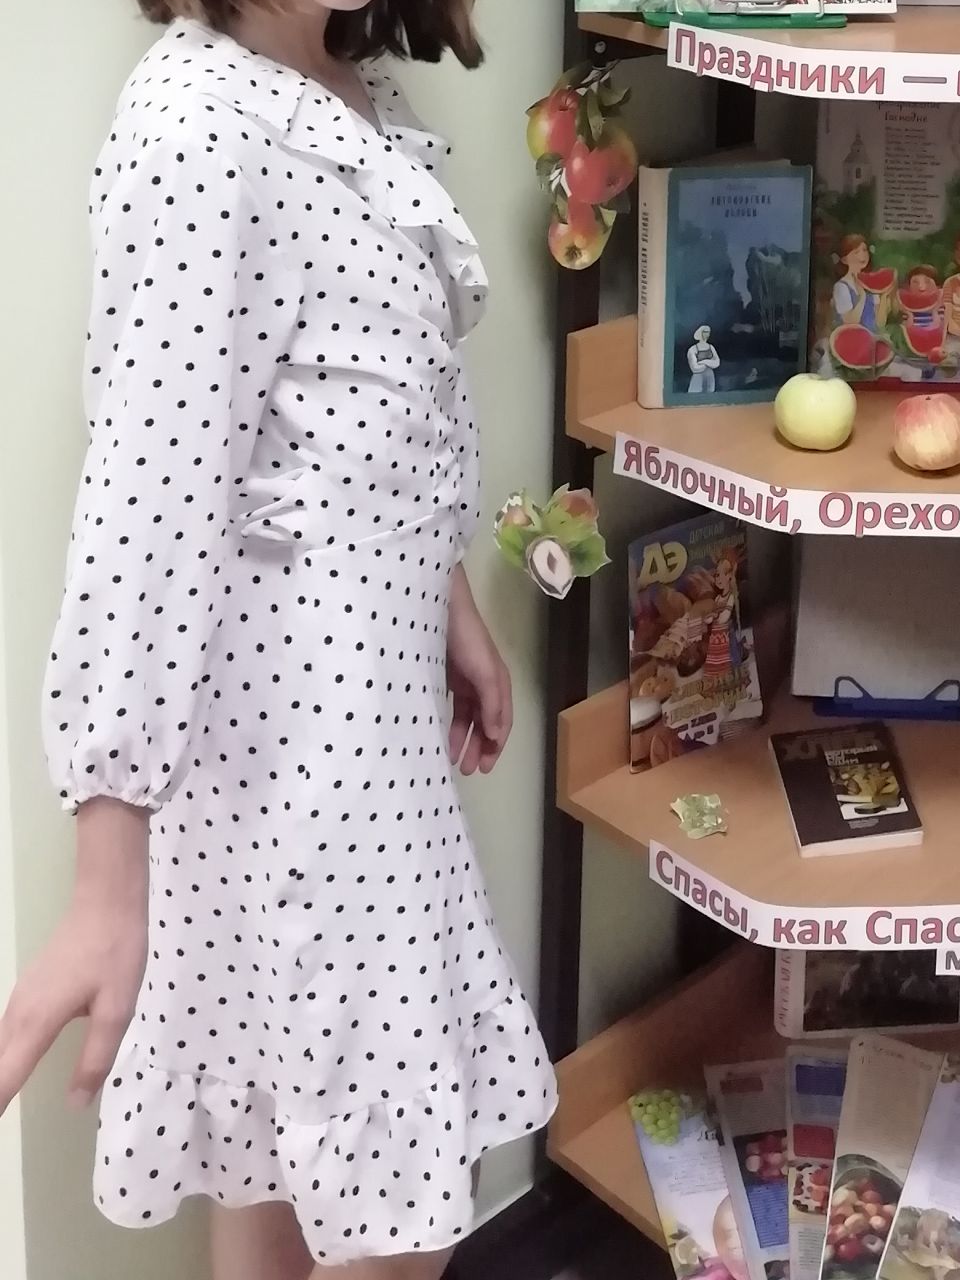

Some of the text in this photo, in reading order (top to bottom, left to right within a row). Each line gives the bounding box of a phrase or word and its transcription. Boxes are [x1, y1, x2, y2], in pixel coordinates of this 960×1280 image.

[675, 27, 886, 93] Праздники
[623, 439, 802, 536] Яблочный,
[639, 541, 689, 586] ДЭ
[655, 849, 759, 943] Спасы,
[772, 913, 848, 945] как
